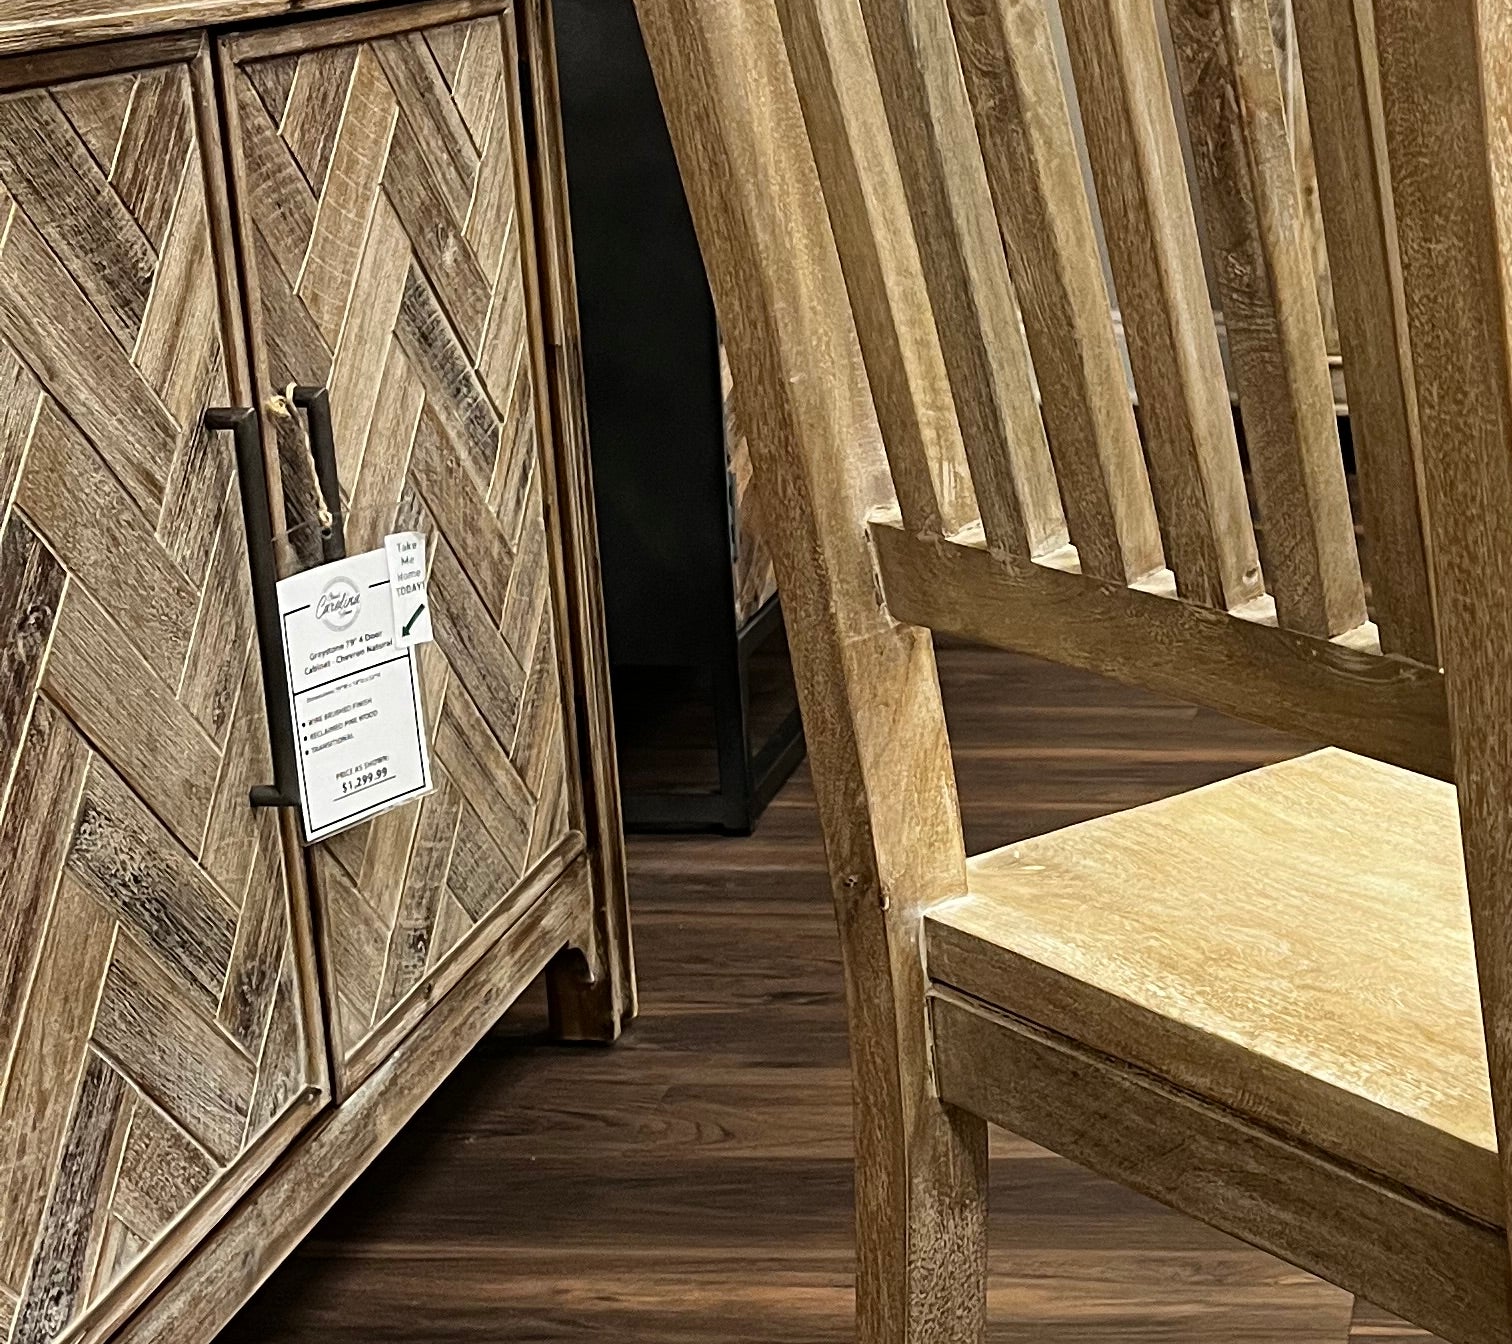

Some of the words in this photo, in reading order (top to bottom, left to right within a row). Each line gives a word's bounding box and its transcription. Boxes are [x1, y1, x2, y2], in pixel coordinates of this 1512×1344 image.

[396, 541, 417, 553] Take
[401, 556, 414, 566] Me
[397, 569, 421, 582] Home
[315, 592, 361, 620] Carolina
[364, 631, 383, 642] Door
[304, 659, 331, 675] Cabinet
[336, 649, 365, 664] Chevron
[366, 638, 393, 653] Natural
[342, 767, 388, 794] $1,299.99
